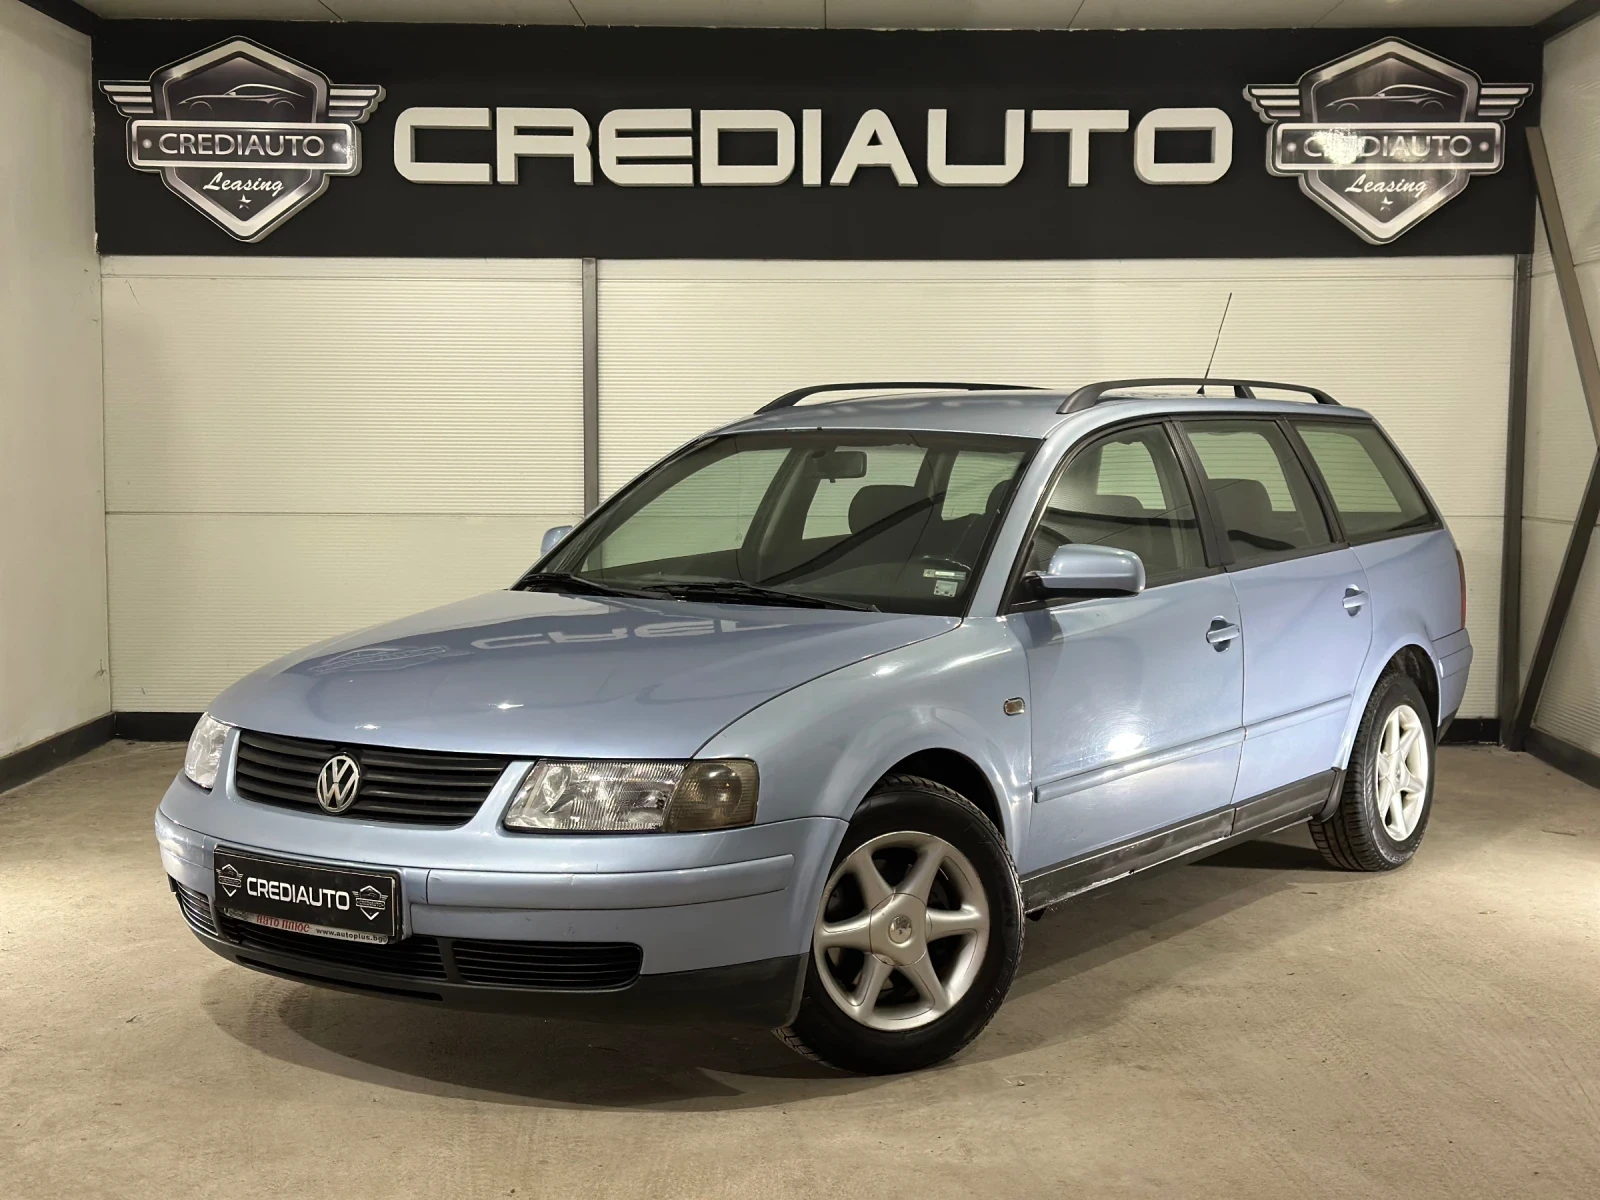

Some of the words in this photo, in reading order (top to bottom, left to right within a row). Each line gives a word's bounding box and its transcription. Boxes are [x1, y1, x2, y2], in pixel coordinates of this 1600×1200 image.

[158, 133, 325, 157] CREDIAUTO
[394, 107, 1233, 187] CREDIAUTO
[1303, 135, 1473, 158] CDIAUTO
[203, 172, 285, 197] Leasing
[1345, 174, 1428, 198] Leasing
[246, 877, 350, 911] CREDIAUTO
[315, 928, 383, 943] www.autoplus.bg
